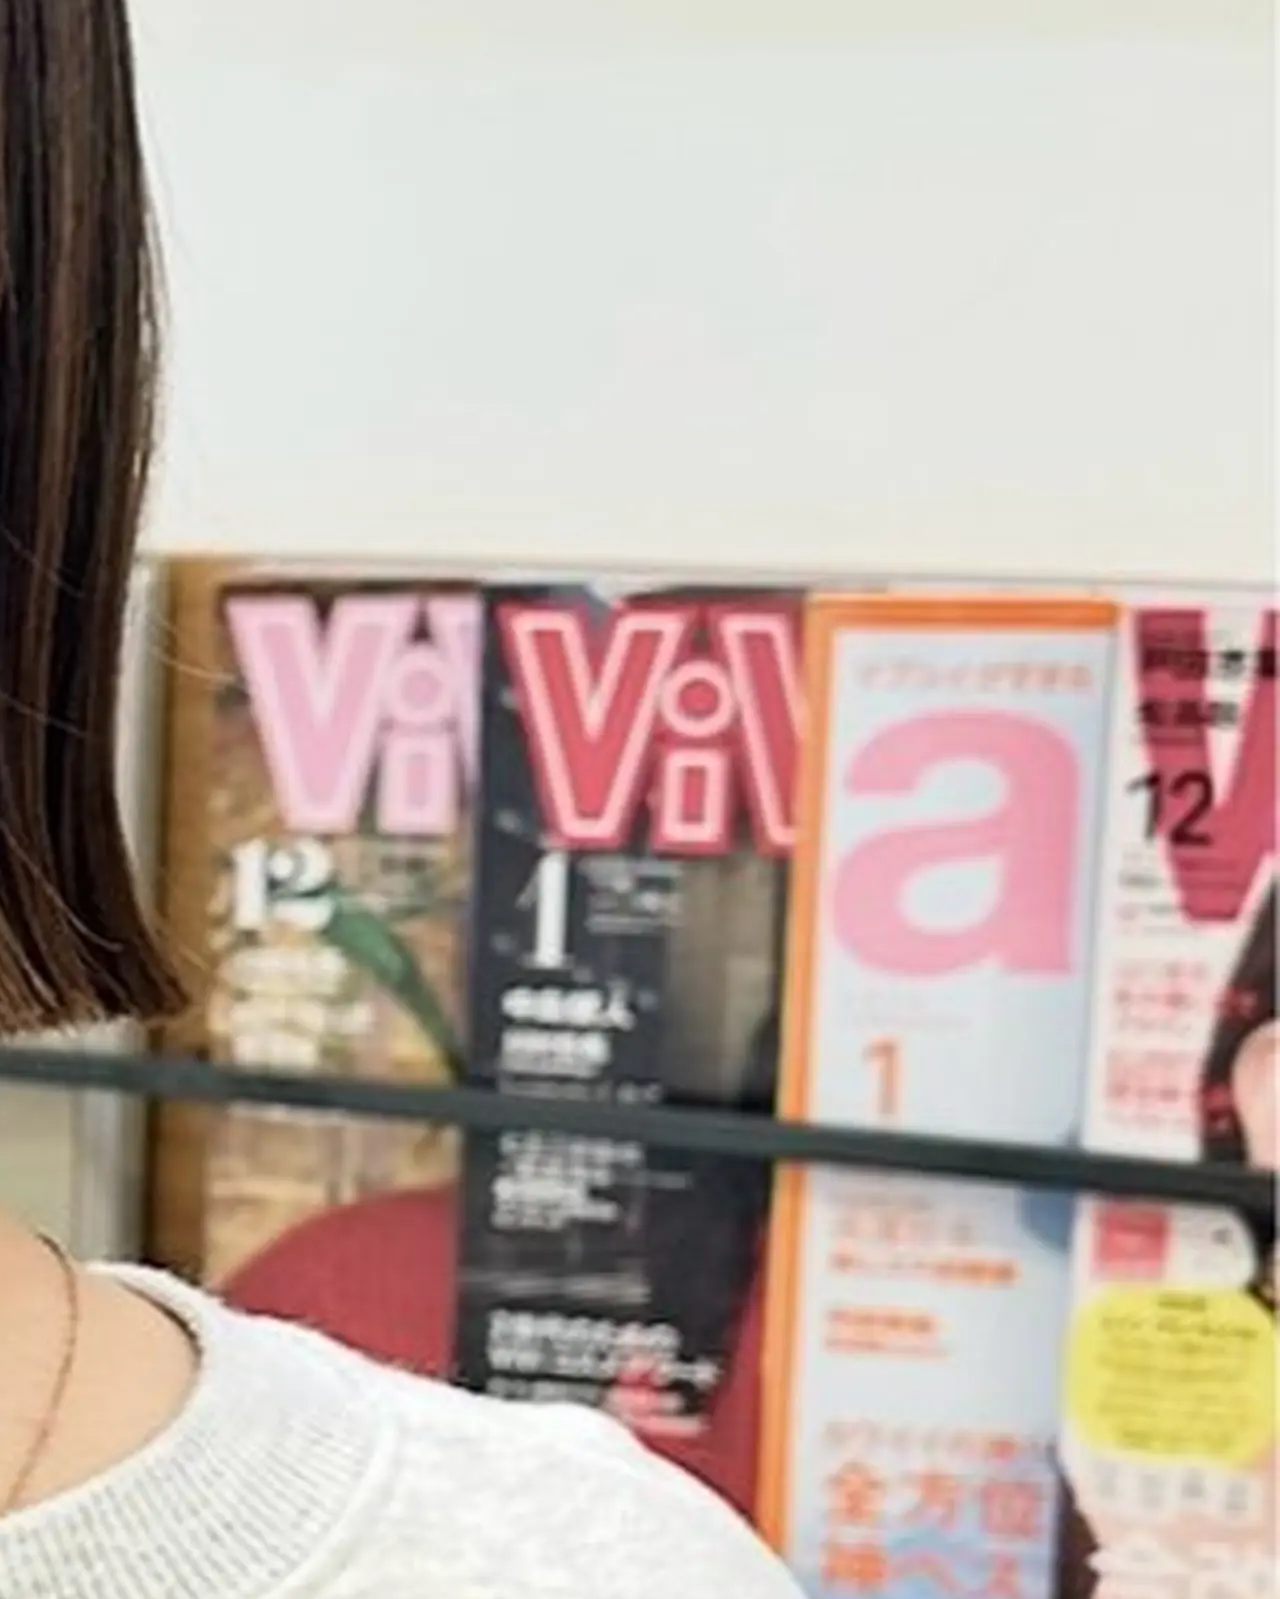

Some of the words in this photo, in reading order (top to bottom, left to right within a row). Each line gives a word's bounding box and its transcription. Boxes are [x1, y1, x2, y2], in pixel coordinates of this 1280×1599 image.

[832, 707, 1083, 978] a
[1127, 768, 1215, 848] 12
[232, 838, 337, 932] 12
[515, 849, 574, 971] 1
[861, 1036, 903, 1117] 1
